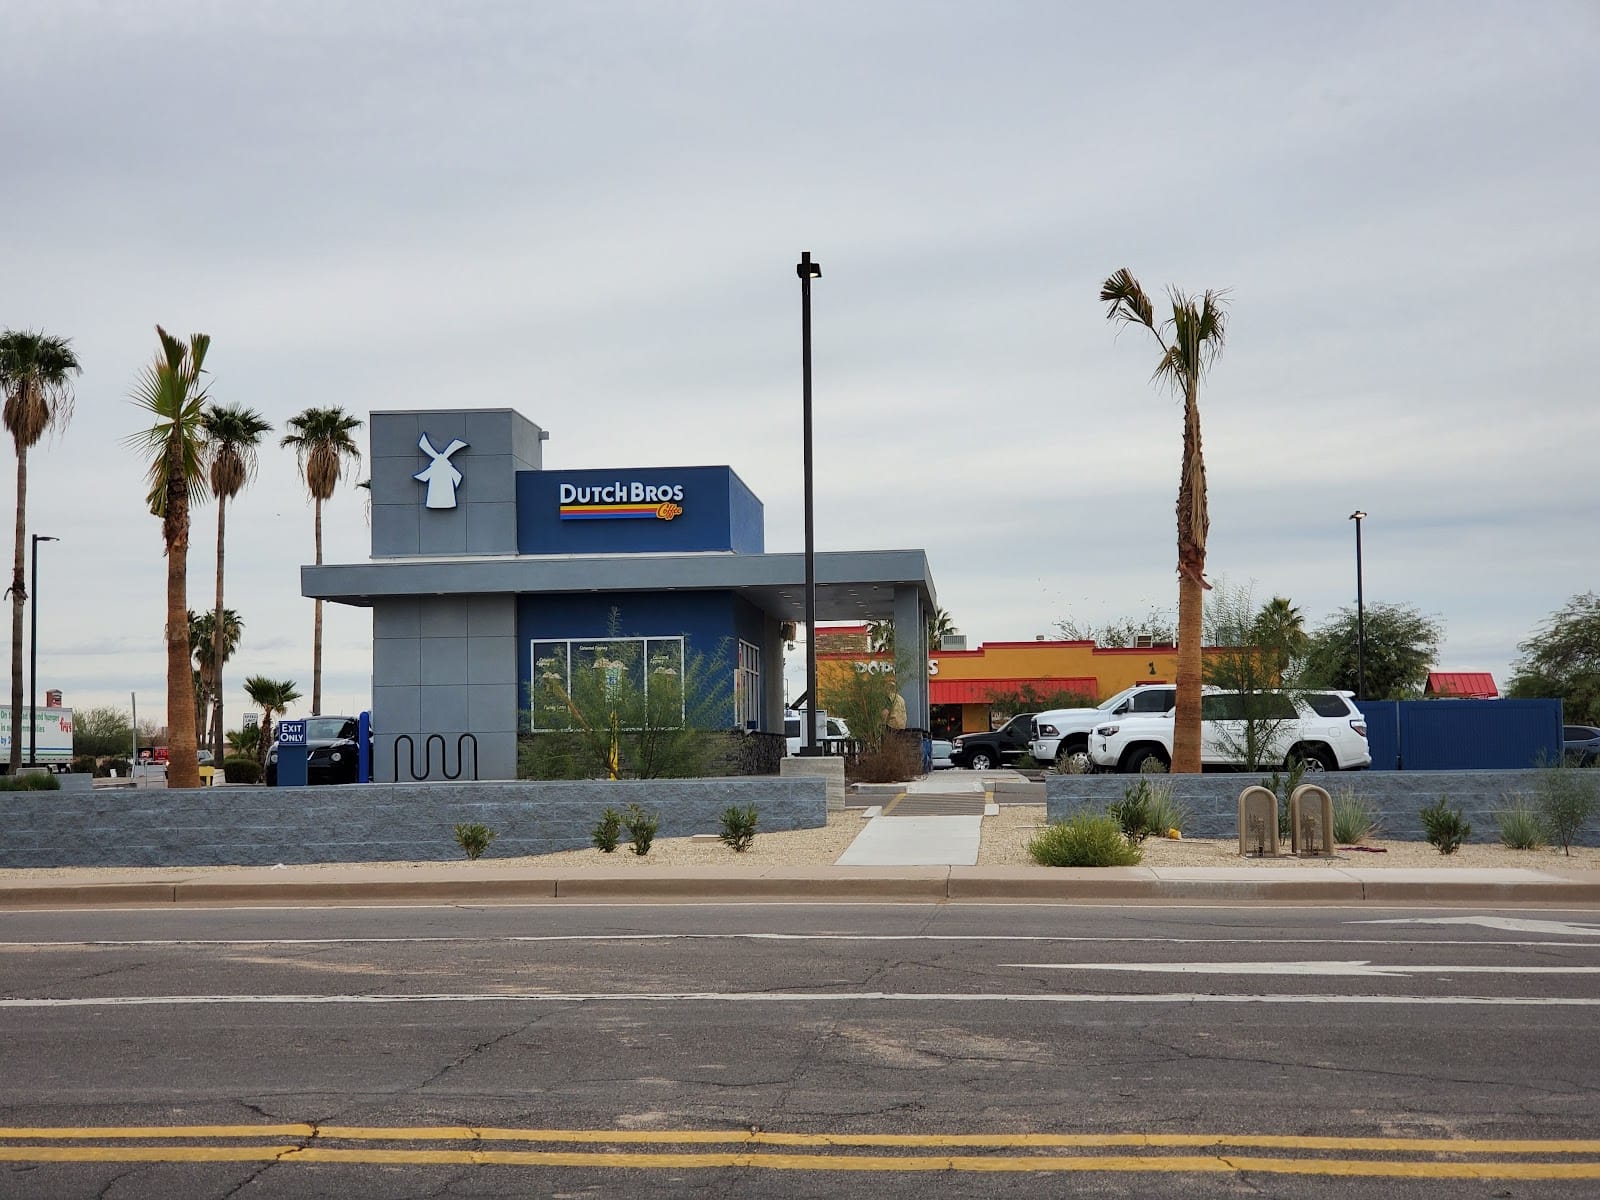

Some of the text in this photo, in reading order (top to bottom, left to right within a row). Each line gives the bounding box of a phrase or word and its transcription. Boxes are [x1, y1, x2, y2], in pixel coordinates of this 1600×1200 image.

[630, 482, 684, 502] BROS
[656, 503, 683, 520] Coffee
[281, 723, 303, 732] EXIT
[280, 733, 304, 742] ONLY
